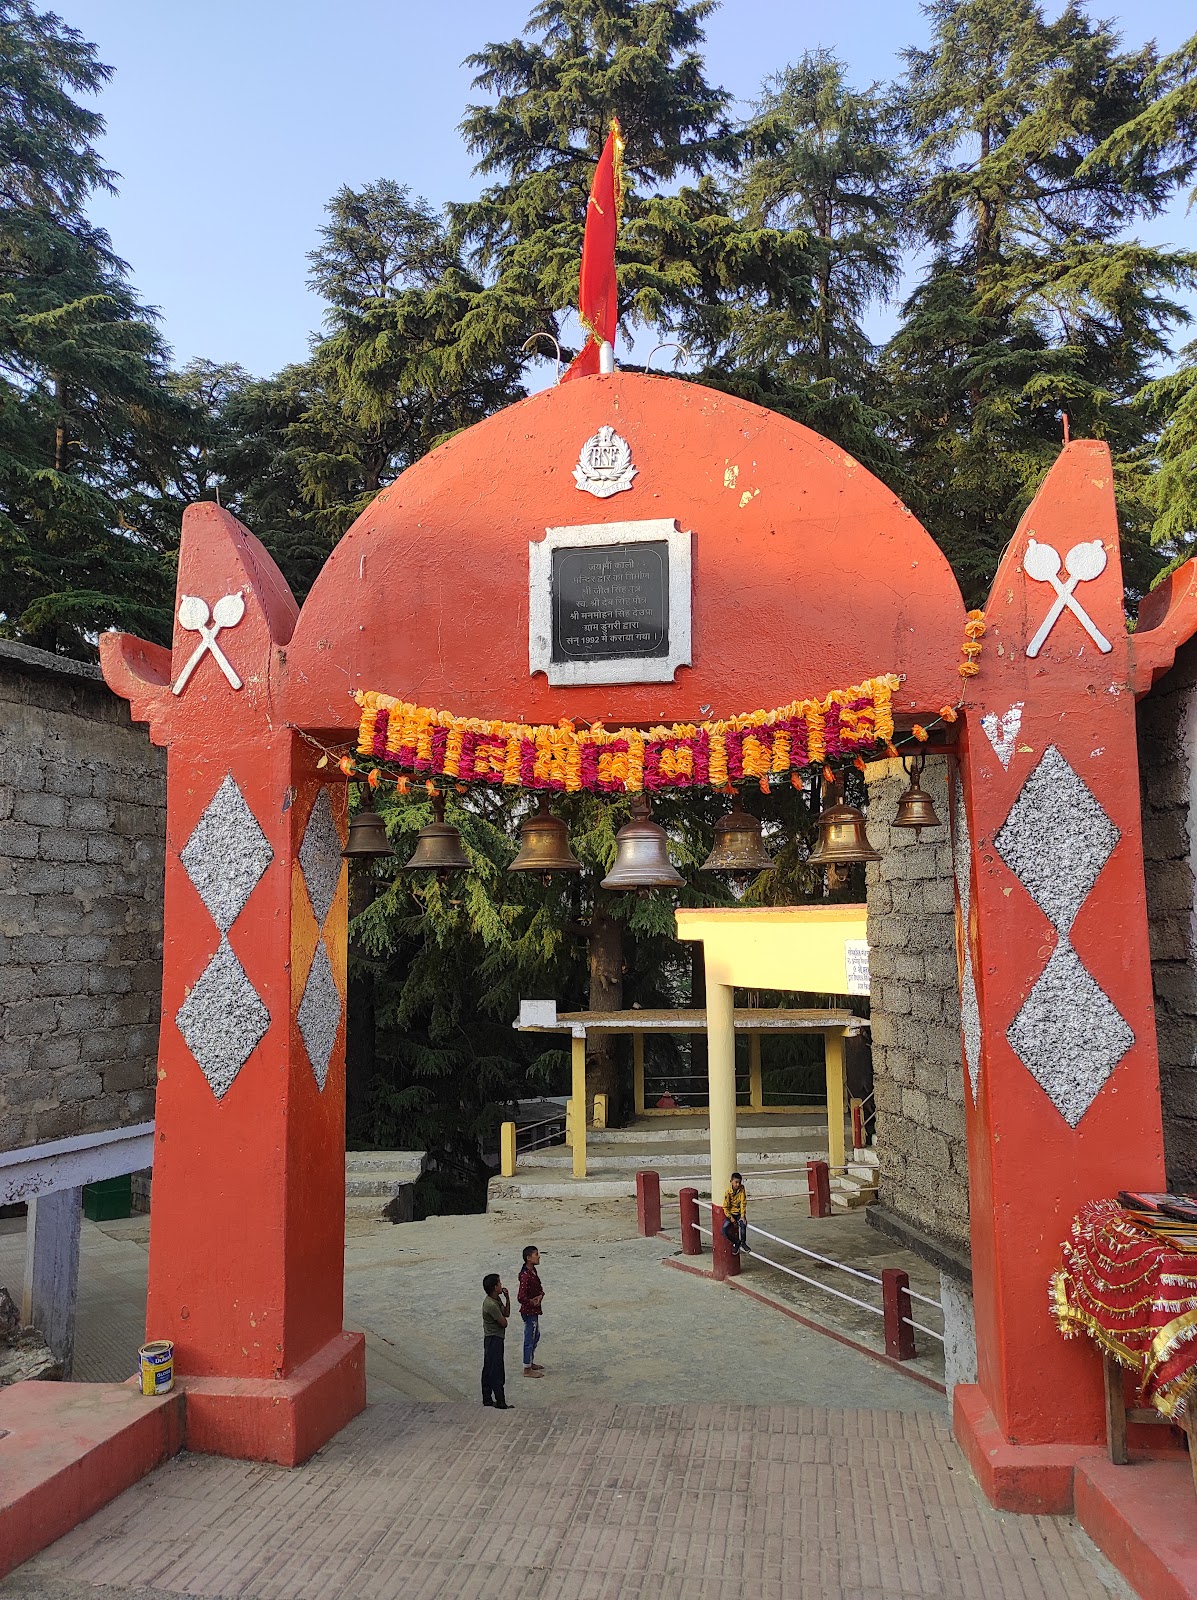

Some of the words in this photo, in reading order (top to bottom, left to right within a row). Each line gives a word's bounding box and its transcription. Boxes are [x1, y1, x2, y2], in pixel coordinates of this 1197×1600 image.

[592, 448, 620, 467] BSF
[614, 559, 634, 568] काली
[582, 586, 592, 595] श्री
[612, 584, 627, 594] सिंह
[590, 597, 600, 607] श्री
[615, 596, 631, 606] सिंह
[570, 611, 579, 620] श्री
[580, 610, 614, 620] मनमोहन
[615, 608, 631, 618] सिंह
[583, 623, 599, 632] ग्राम
[622, 621, 640, 630] द्वारा
[581, 636, 600, 644] 1992
[609, 634, 634, 643] कराया
[635, 632, 651, 641] गया
